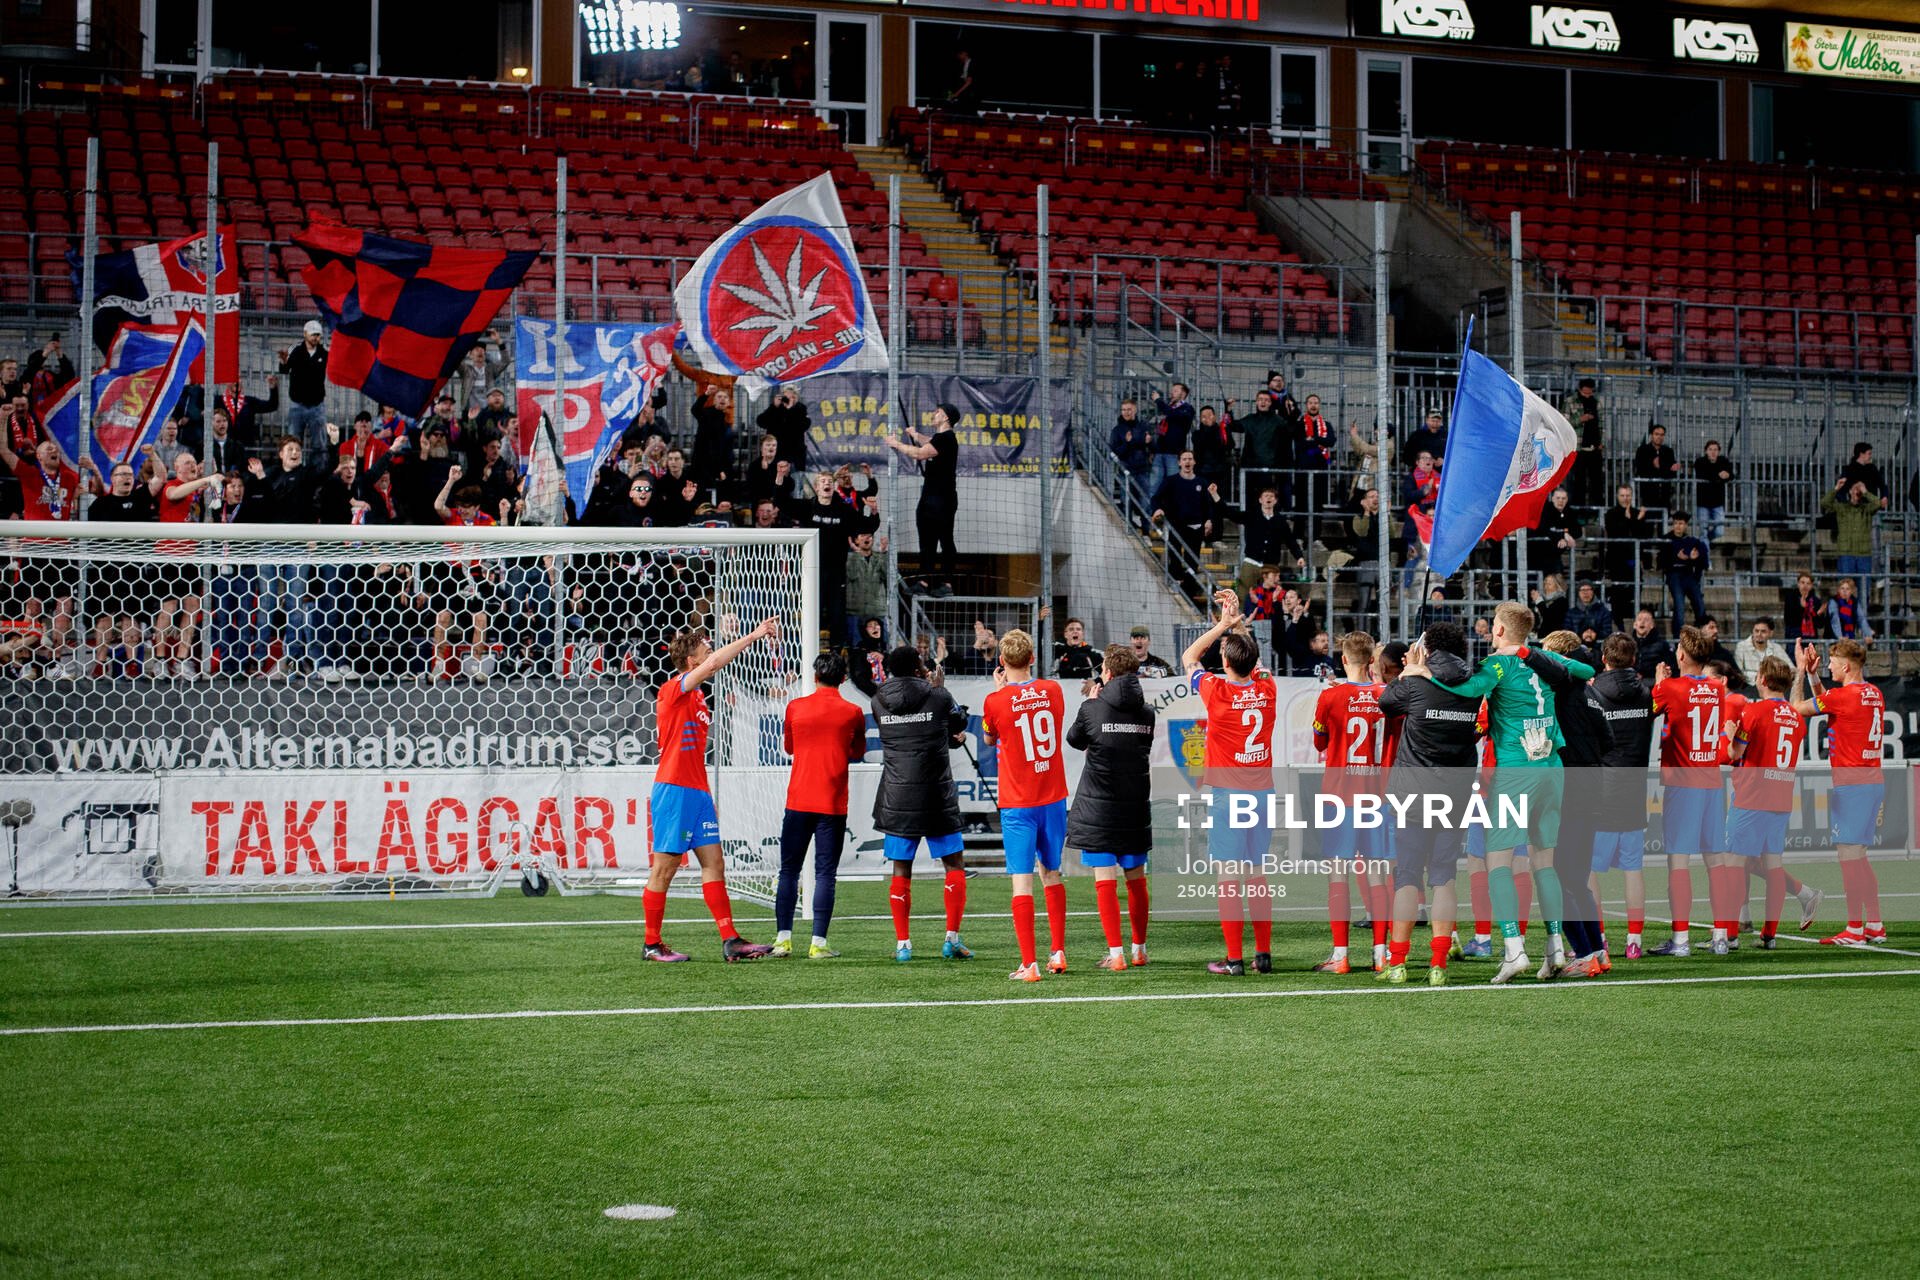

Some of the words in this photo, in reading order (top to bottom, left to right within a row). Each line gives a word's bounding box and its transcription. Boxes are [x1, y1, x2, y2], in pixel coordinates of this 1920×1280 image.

[1448, 26, 1474, 40] 1977
[1531, 5, 1621, 50] KOSA
[1595, 38, 1620, 52] 1977
[1673, 18, 1759, 62] KOSA
[1814, 37, 1839, 50] Stora
[1734, 51, 1759, 64] 1977
[1425, 709, 1471, 722] HELSINGBORGS
[1528, 672, 1545, 716] 1
[51, 726, 643, 770] www.Alternabadrum.se
[1014, 710, 1057, 762] 19
[1241, 708, 1265, 754] 2
[1346, 716, 1386, 764] 21
[1687, 706, 1720, 751] 14
[1776, 726, 1794, 770] 5
[1868, 707, 1881, 749] 4
